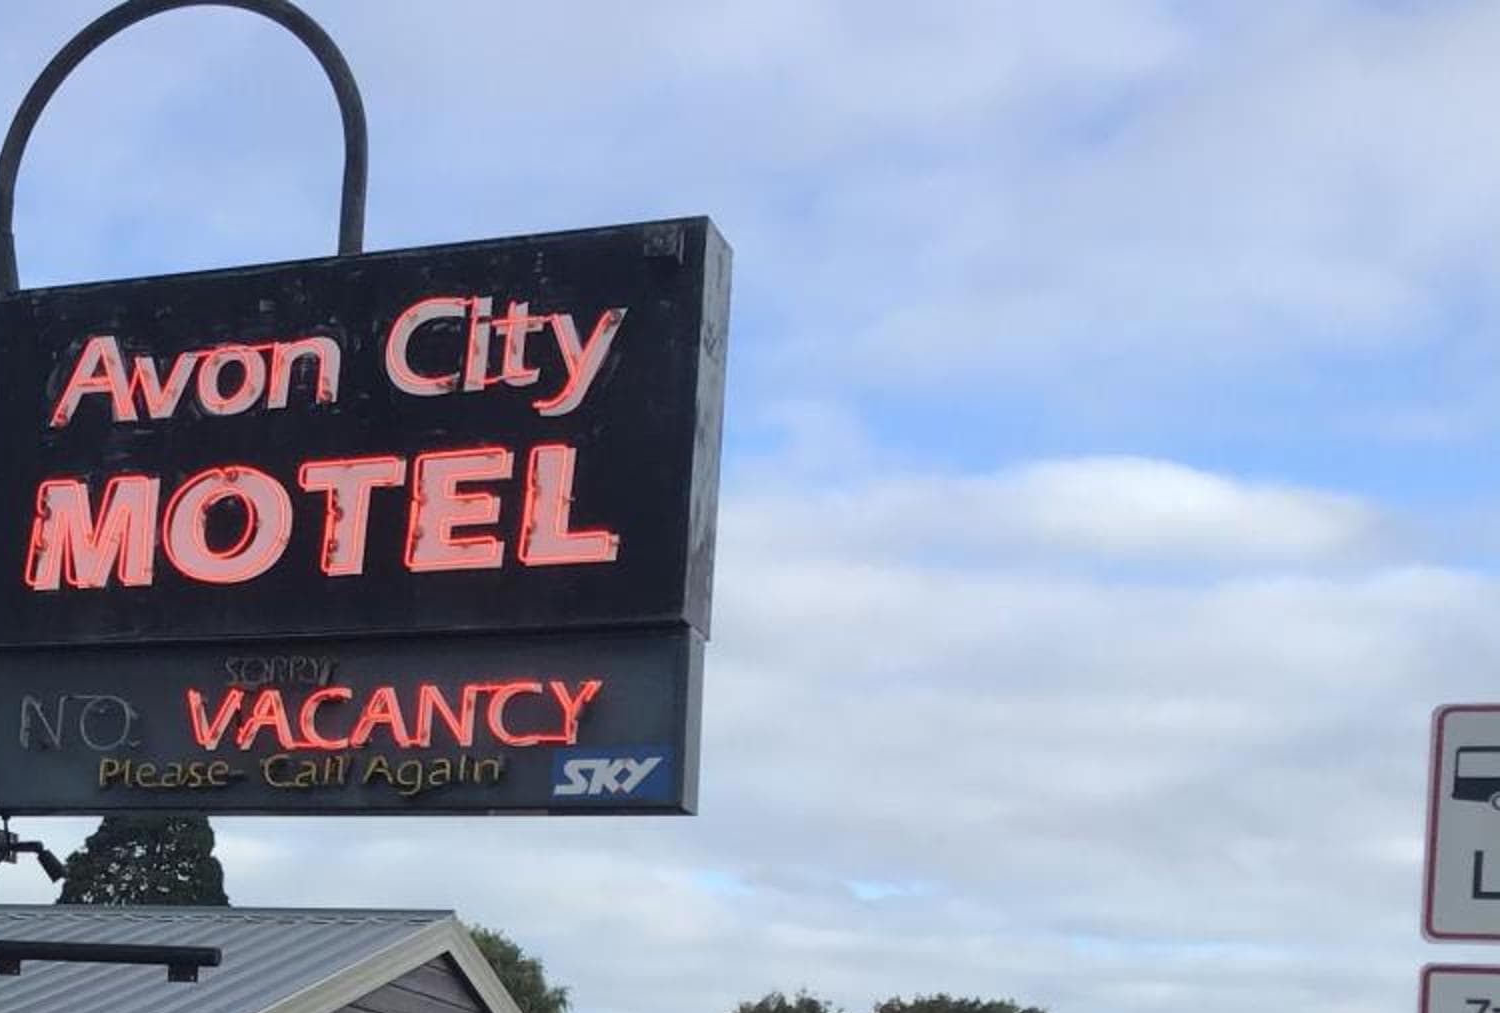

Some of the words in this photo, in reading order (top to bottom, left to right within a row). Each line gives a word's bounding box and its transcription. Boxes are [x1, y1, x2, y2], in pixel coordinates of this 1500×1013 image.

[49, 334, 342, 429] Avon
[385, 295, 629, 417] City
[24, 443, 621, 591] MOTEL
[186, 679, 602, 751] VACANCY
[99, 755, 232, 789] Please
[262, 753, 348, 788] Call
[362, 752, 501, 796] Again
[553, 756, 664, 796] SKY
